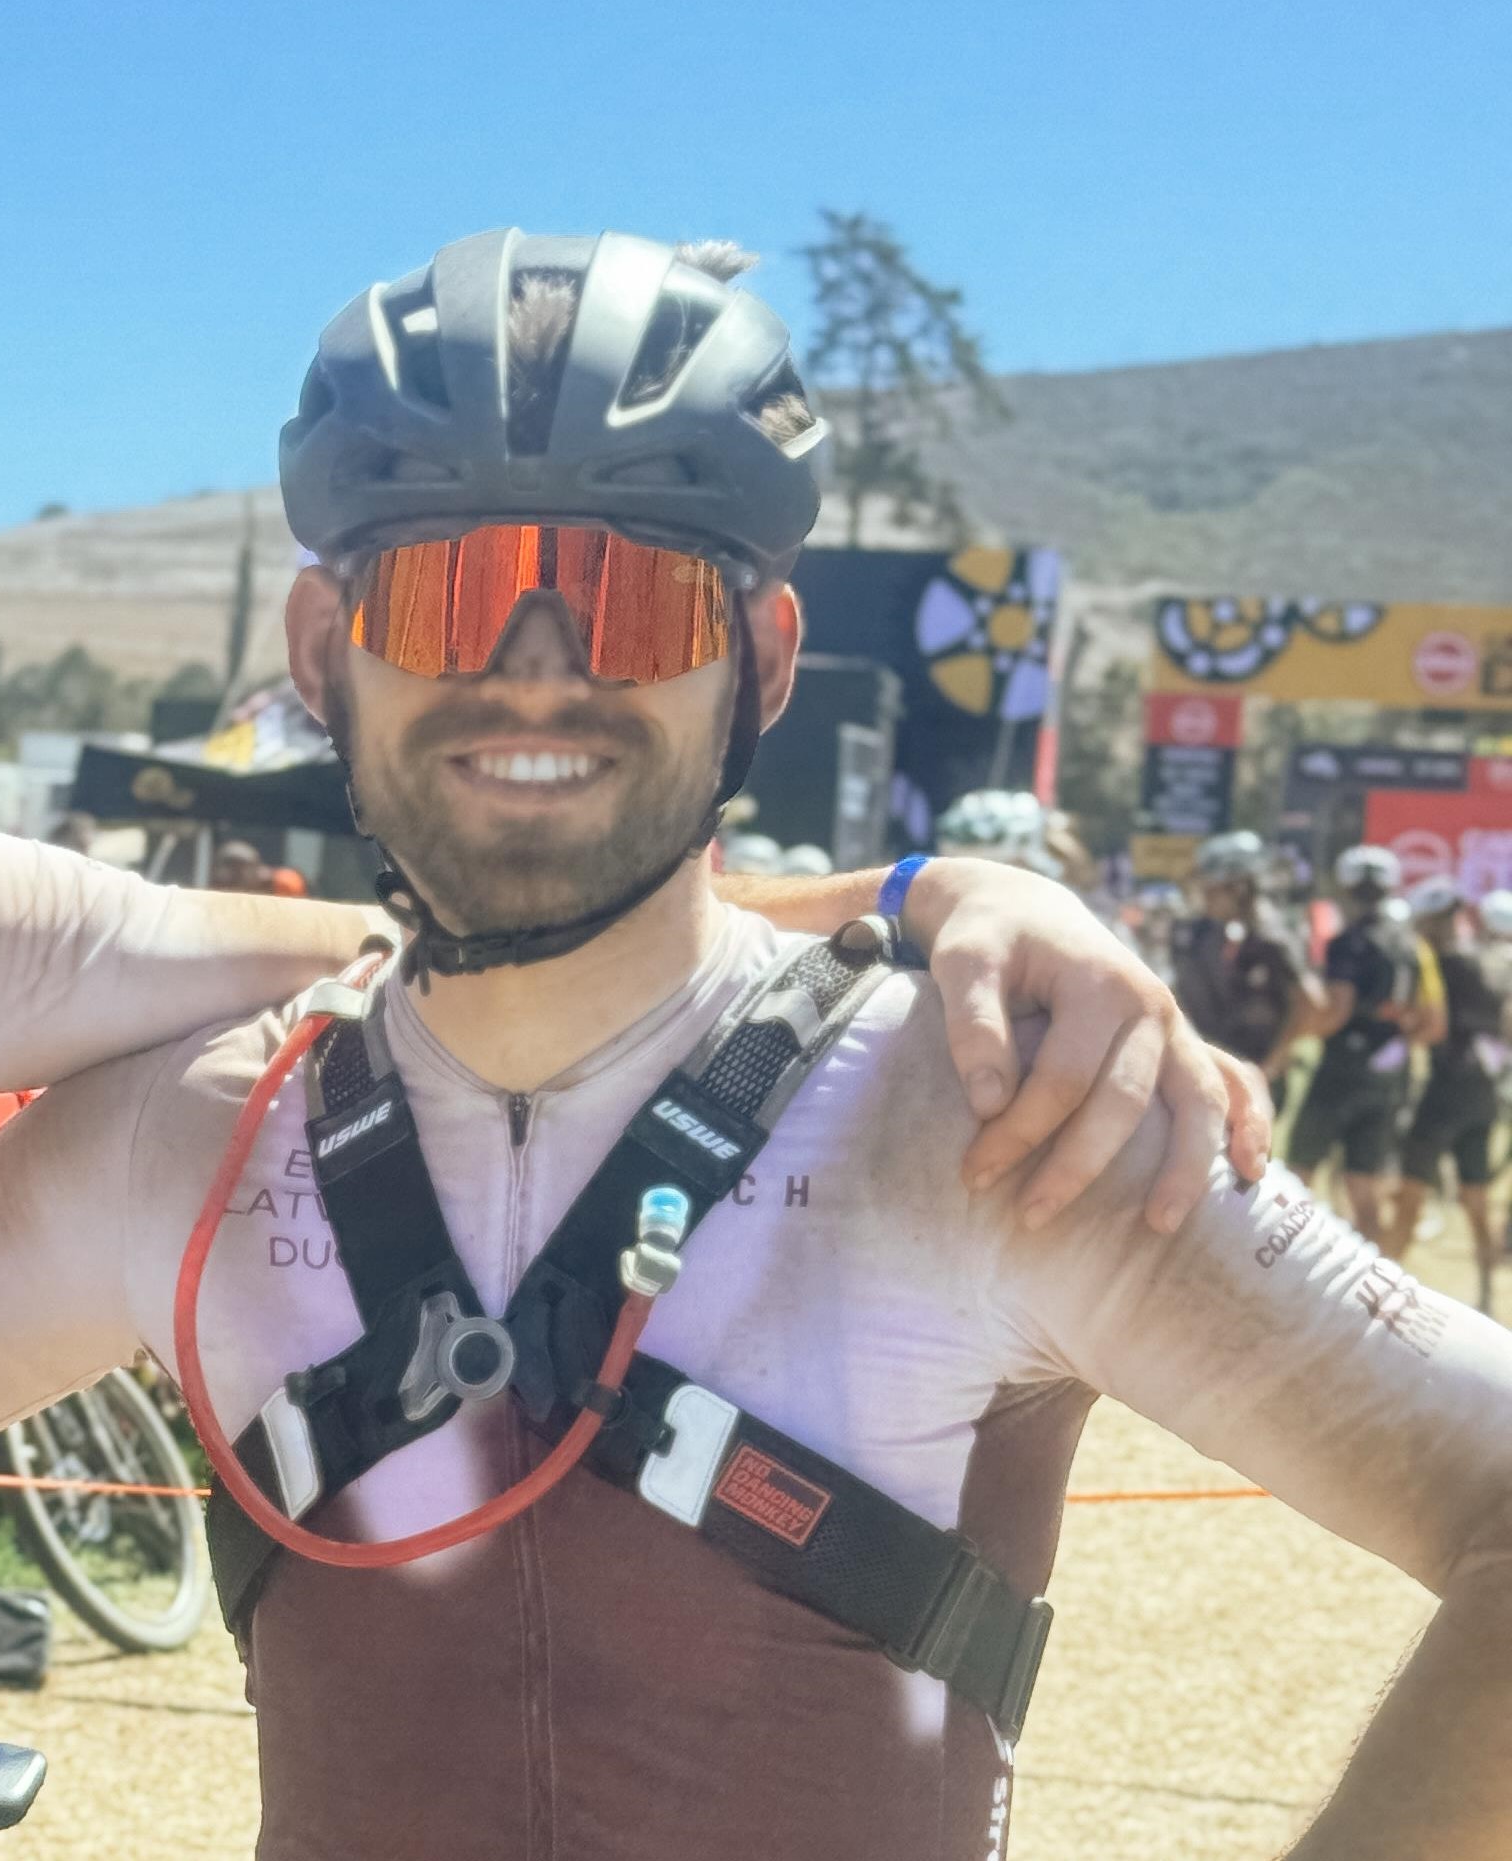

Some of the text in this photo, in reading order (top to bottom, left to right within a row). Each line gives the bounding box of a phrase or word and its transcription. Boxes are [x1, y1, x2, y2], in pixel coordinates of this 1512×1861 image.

[318, 1101, 392, 1159] USWE
[652, 1100, 741, 1160] USWE
[269, 1236, 345, 1270] DU
[731, 1466, 814, 1523] DANCING
[739, 1454, 771, 1480] NO
[723, 1480, 803, 1534] MONKEY
